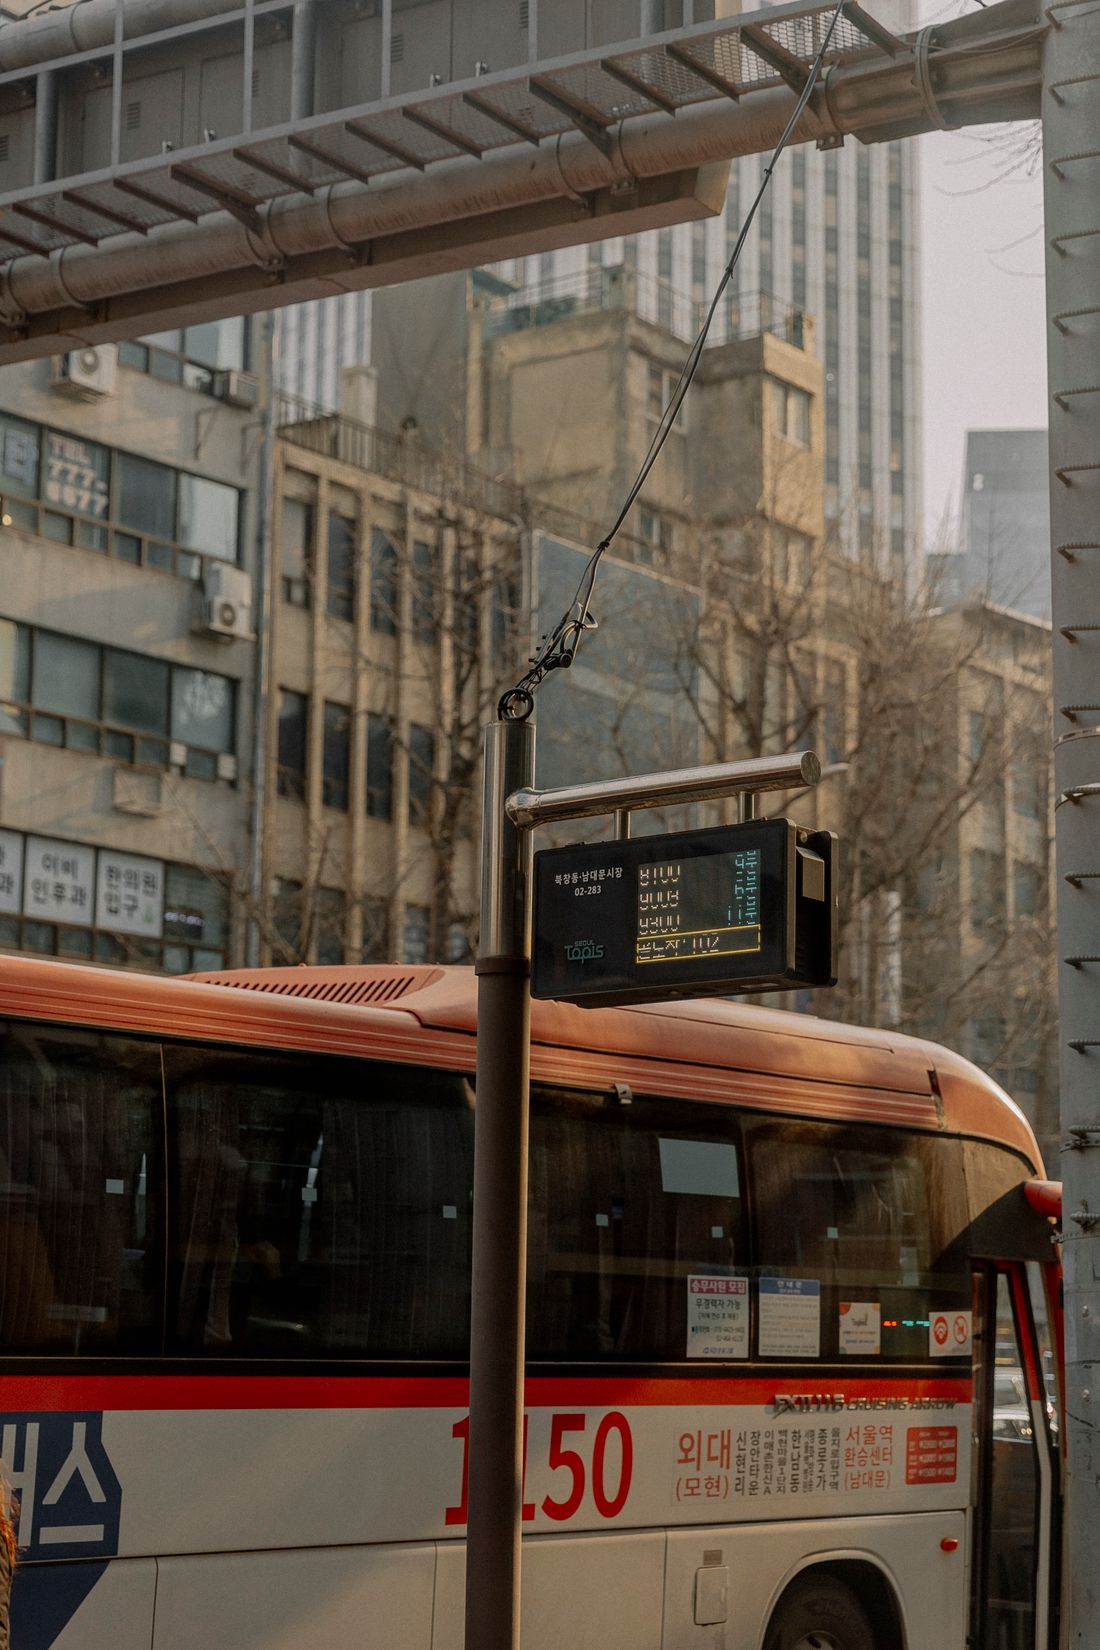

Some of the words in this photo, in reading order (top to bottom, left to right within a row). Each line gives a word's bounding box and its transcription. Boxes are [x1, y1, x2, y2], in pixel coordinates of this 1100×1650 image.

[574, 885, 602, 896] 02-283
[691, 1280, 726, 1293] 승무사원
[728, 1281, 745, 1294] 모집
[909, 1397, 958, 1411] ARROW
[846, 1424, 893, 1445] 서울역
[677, 1429, 731, 1471] 외대
[790, 1429, 801, 1493] 한남동
[817, 1428, 828, 1491] 종로2가
[844, 1446, 893, 1467] 환승센터
[735, 1431, 746, 1496] 신현리
[749, 1430, 760, 1496] 장안타운
[676, 1475, 729, 1501] (모현)
[844, 1470, 891, 1490] (남대문)
